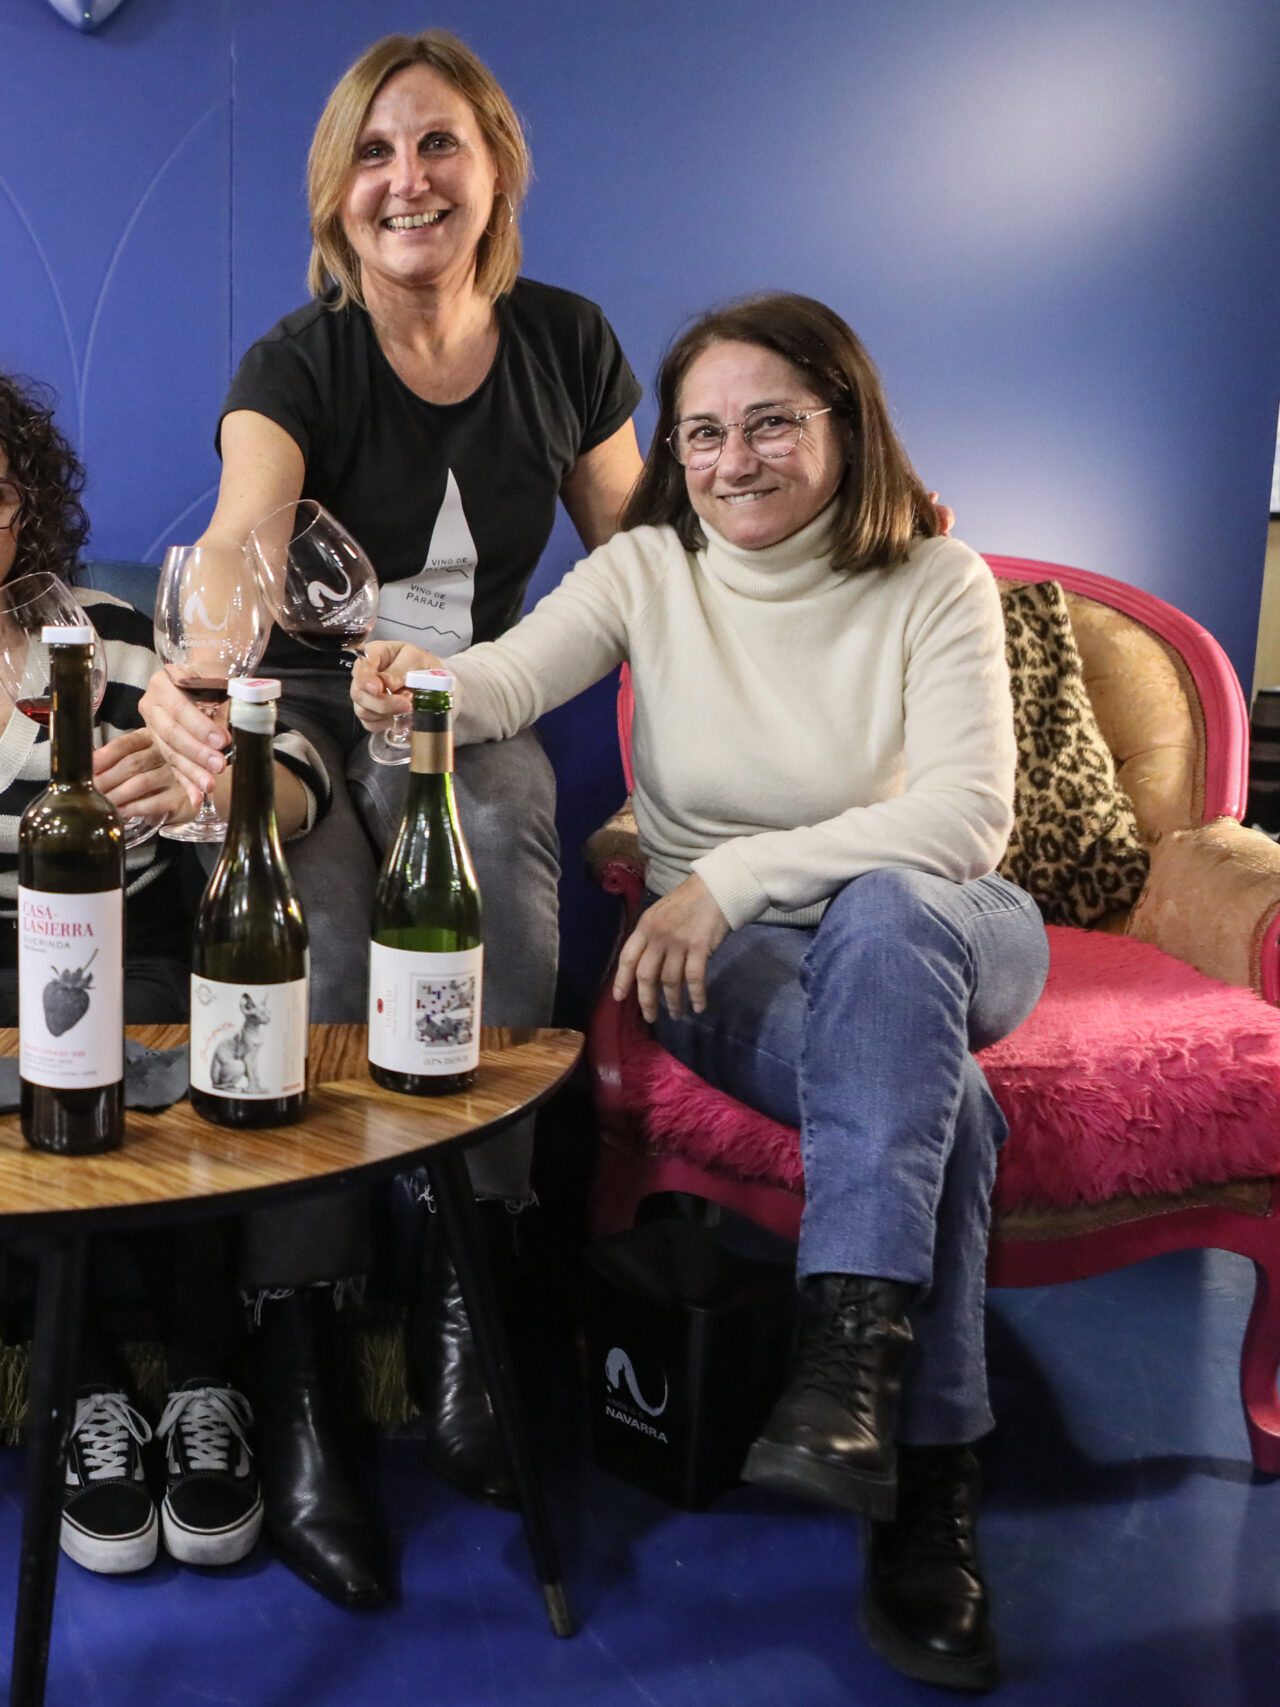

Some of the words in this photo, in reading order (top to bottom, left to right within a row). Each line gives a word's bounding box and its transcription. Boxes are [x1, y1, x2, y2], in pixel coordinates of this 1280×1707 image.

[431, 558, 453, 566] VINO
[456, 557, 468, 565] DE
[406, 592, 447, 610] PARAJE
[410, 584, 432, 596] VINO
[434, 591, 447, 600] DE
[23, 920, 95, 938] LASIERRA
[605, 1406, 669, 1444] NAVARRA
